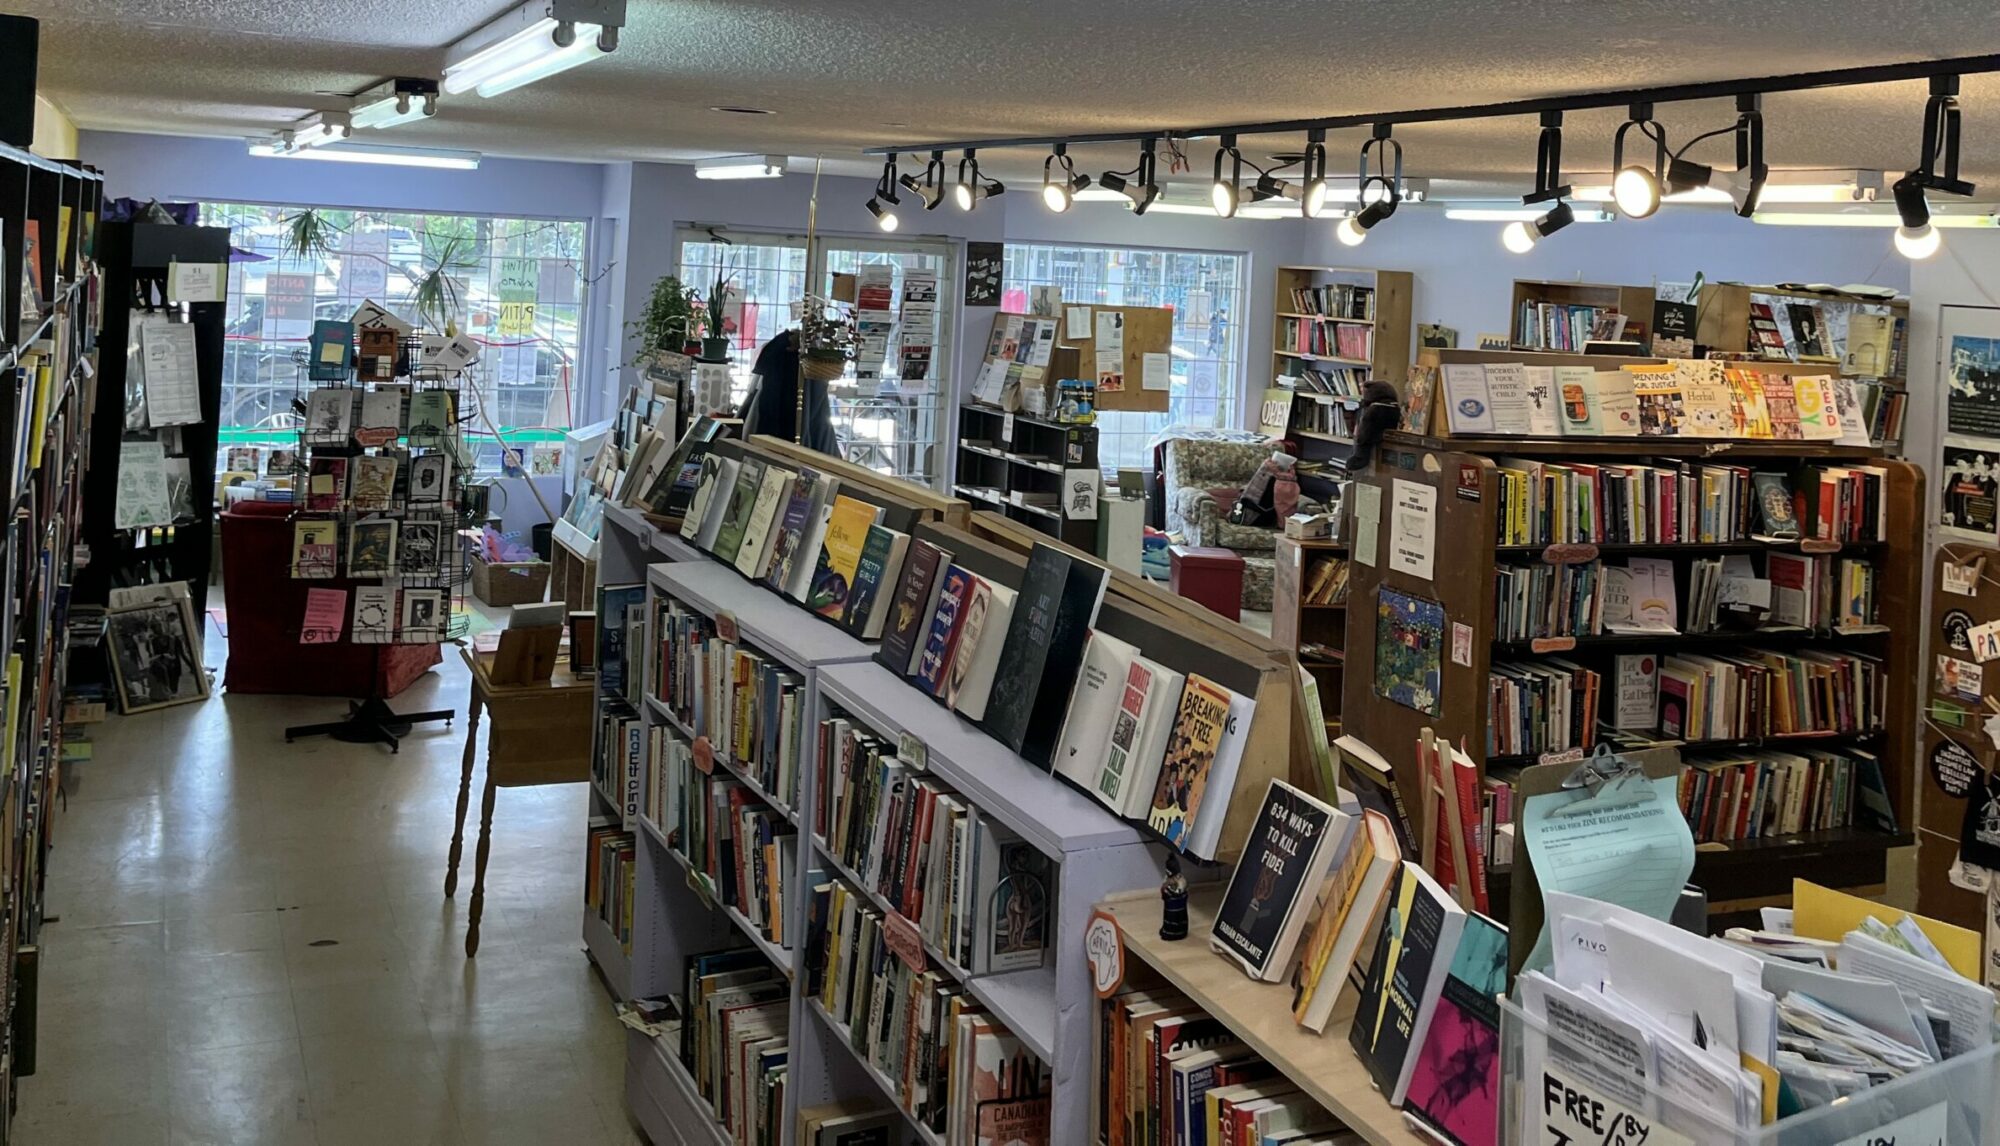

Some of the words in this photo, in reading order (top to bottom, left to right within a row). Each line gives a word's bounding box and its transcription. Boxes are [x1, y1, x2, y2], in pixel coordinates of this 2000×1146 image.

[1261, 400, 1290, 427] OPEN
[1184, 691, 1226, 726] BREAKING
[1192, 719, 1212, 745] FREE
[1270, 803, 1288, 823] 634
[1289, 813, 1314, 838] WAYS
[1583, 818, 1598, 827] ZINE
[1266, 826, 1279, 843] TO
[1280, 836, 1297, 857] KILL
[1261, 850, 1285, 876] FIDEL
[1389, 986, 1413, 1024] NORMAL
[1396, 1015, 1410, 1039] LIFE
